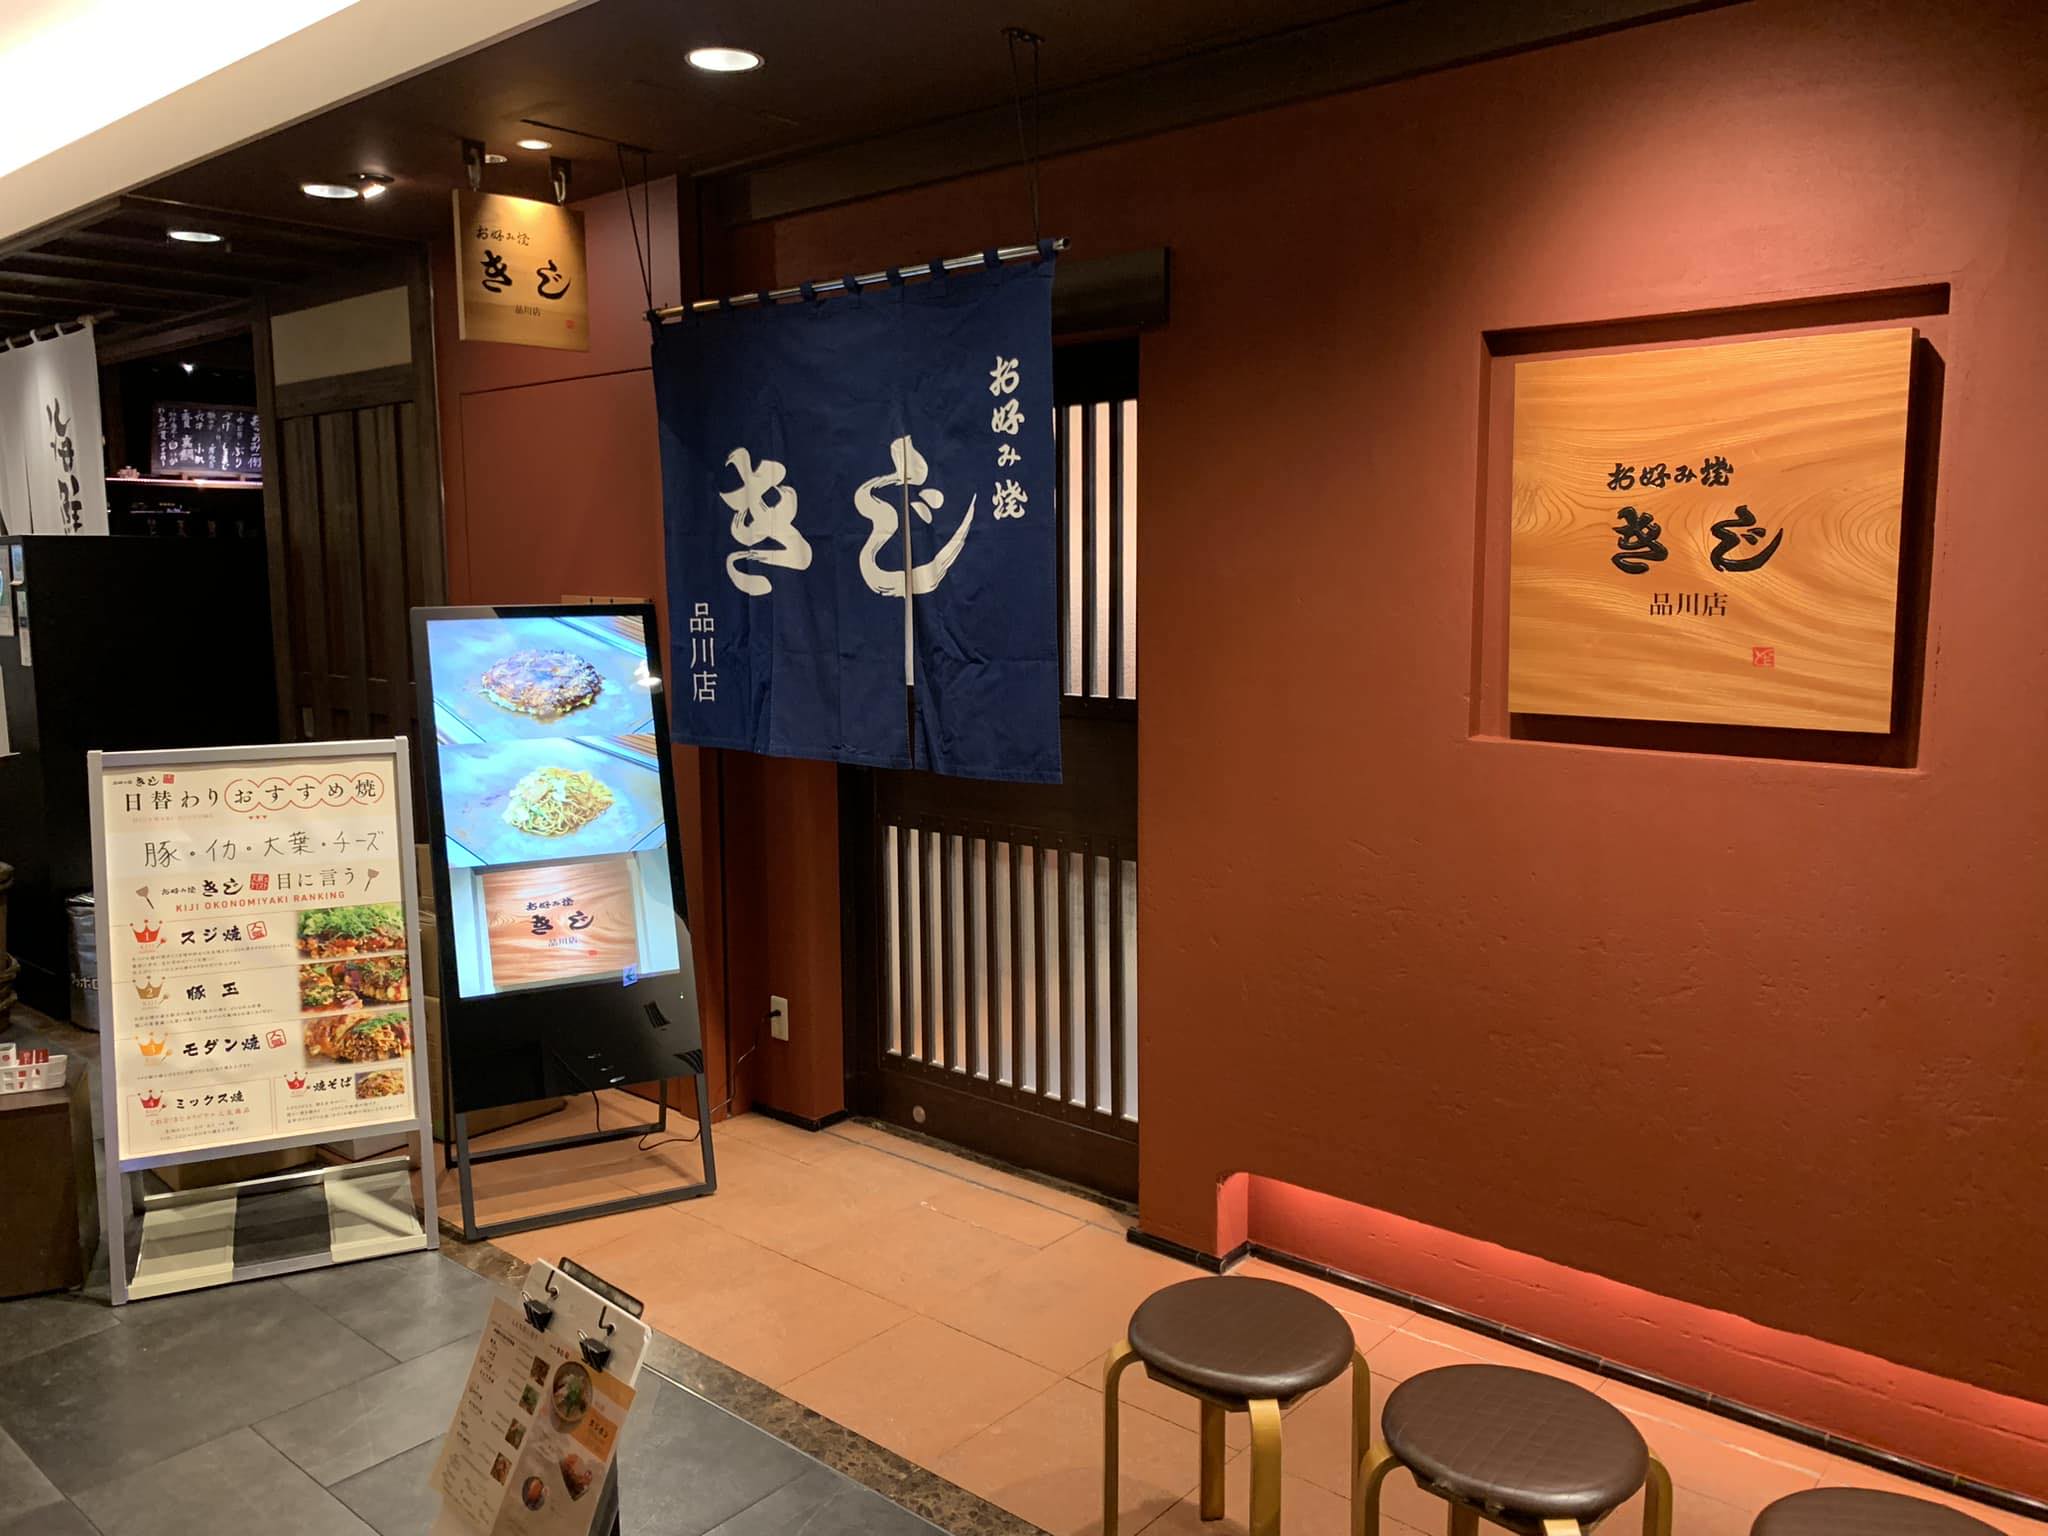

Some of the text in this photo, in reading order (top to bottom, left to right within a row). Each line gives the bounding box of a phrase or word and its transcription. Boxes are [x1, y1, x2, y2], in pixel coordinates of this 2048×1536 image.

[476, 224, 530, 246] お好み焼
[480, 249, 571, 300] きじ
[989, 355, 1028, 520] お好み焼
[1606, 455, 1735, 491] お好み焼
[719, 434, 978, 599] きじ
[1610, 504, 1784, 575] きじ
[1649, 592, 1728, 617] 品川店
[689, 602, 718, 702] 品川店
[175, 891, 345, 913] KIJI OKONOMIYAKI RANKING
[180, 925, 242, 945] スジ焼
[531, 910, 595, 936] きじ
[186, 981, 239, 1001] 豚玉
[183, 1034, 260, 1056] モダン焼
[313, 1076, 352, 1092] 焼そば
[176, 1090, 245, 1109] ミックス焼
